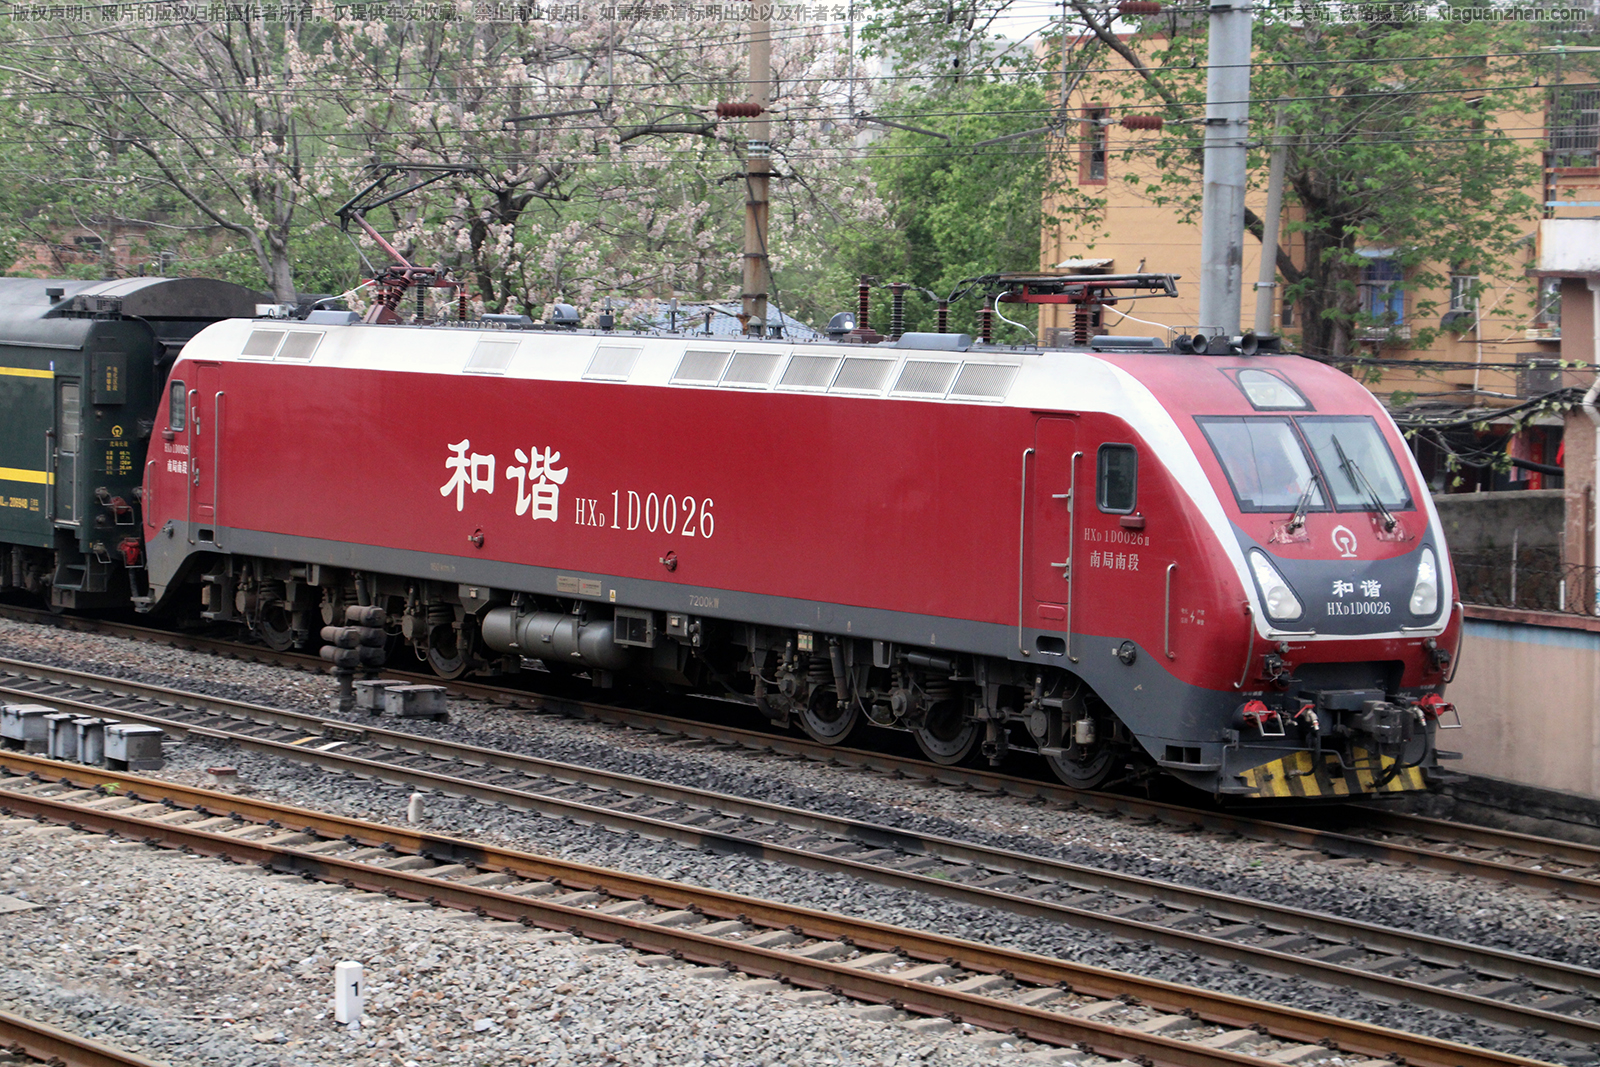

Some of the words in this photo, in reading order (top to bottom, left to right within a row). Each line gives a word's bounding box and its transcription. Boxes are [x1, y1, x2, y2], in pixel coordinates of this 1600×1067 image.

[440, 439, 569, 522] 和谐
[1090, 550, 1139, 571] 南局南段
[1332, 580, 1381, 597] 和谐
[351, 981, 358, 997] 1
